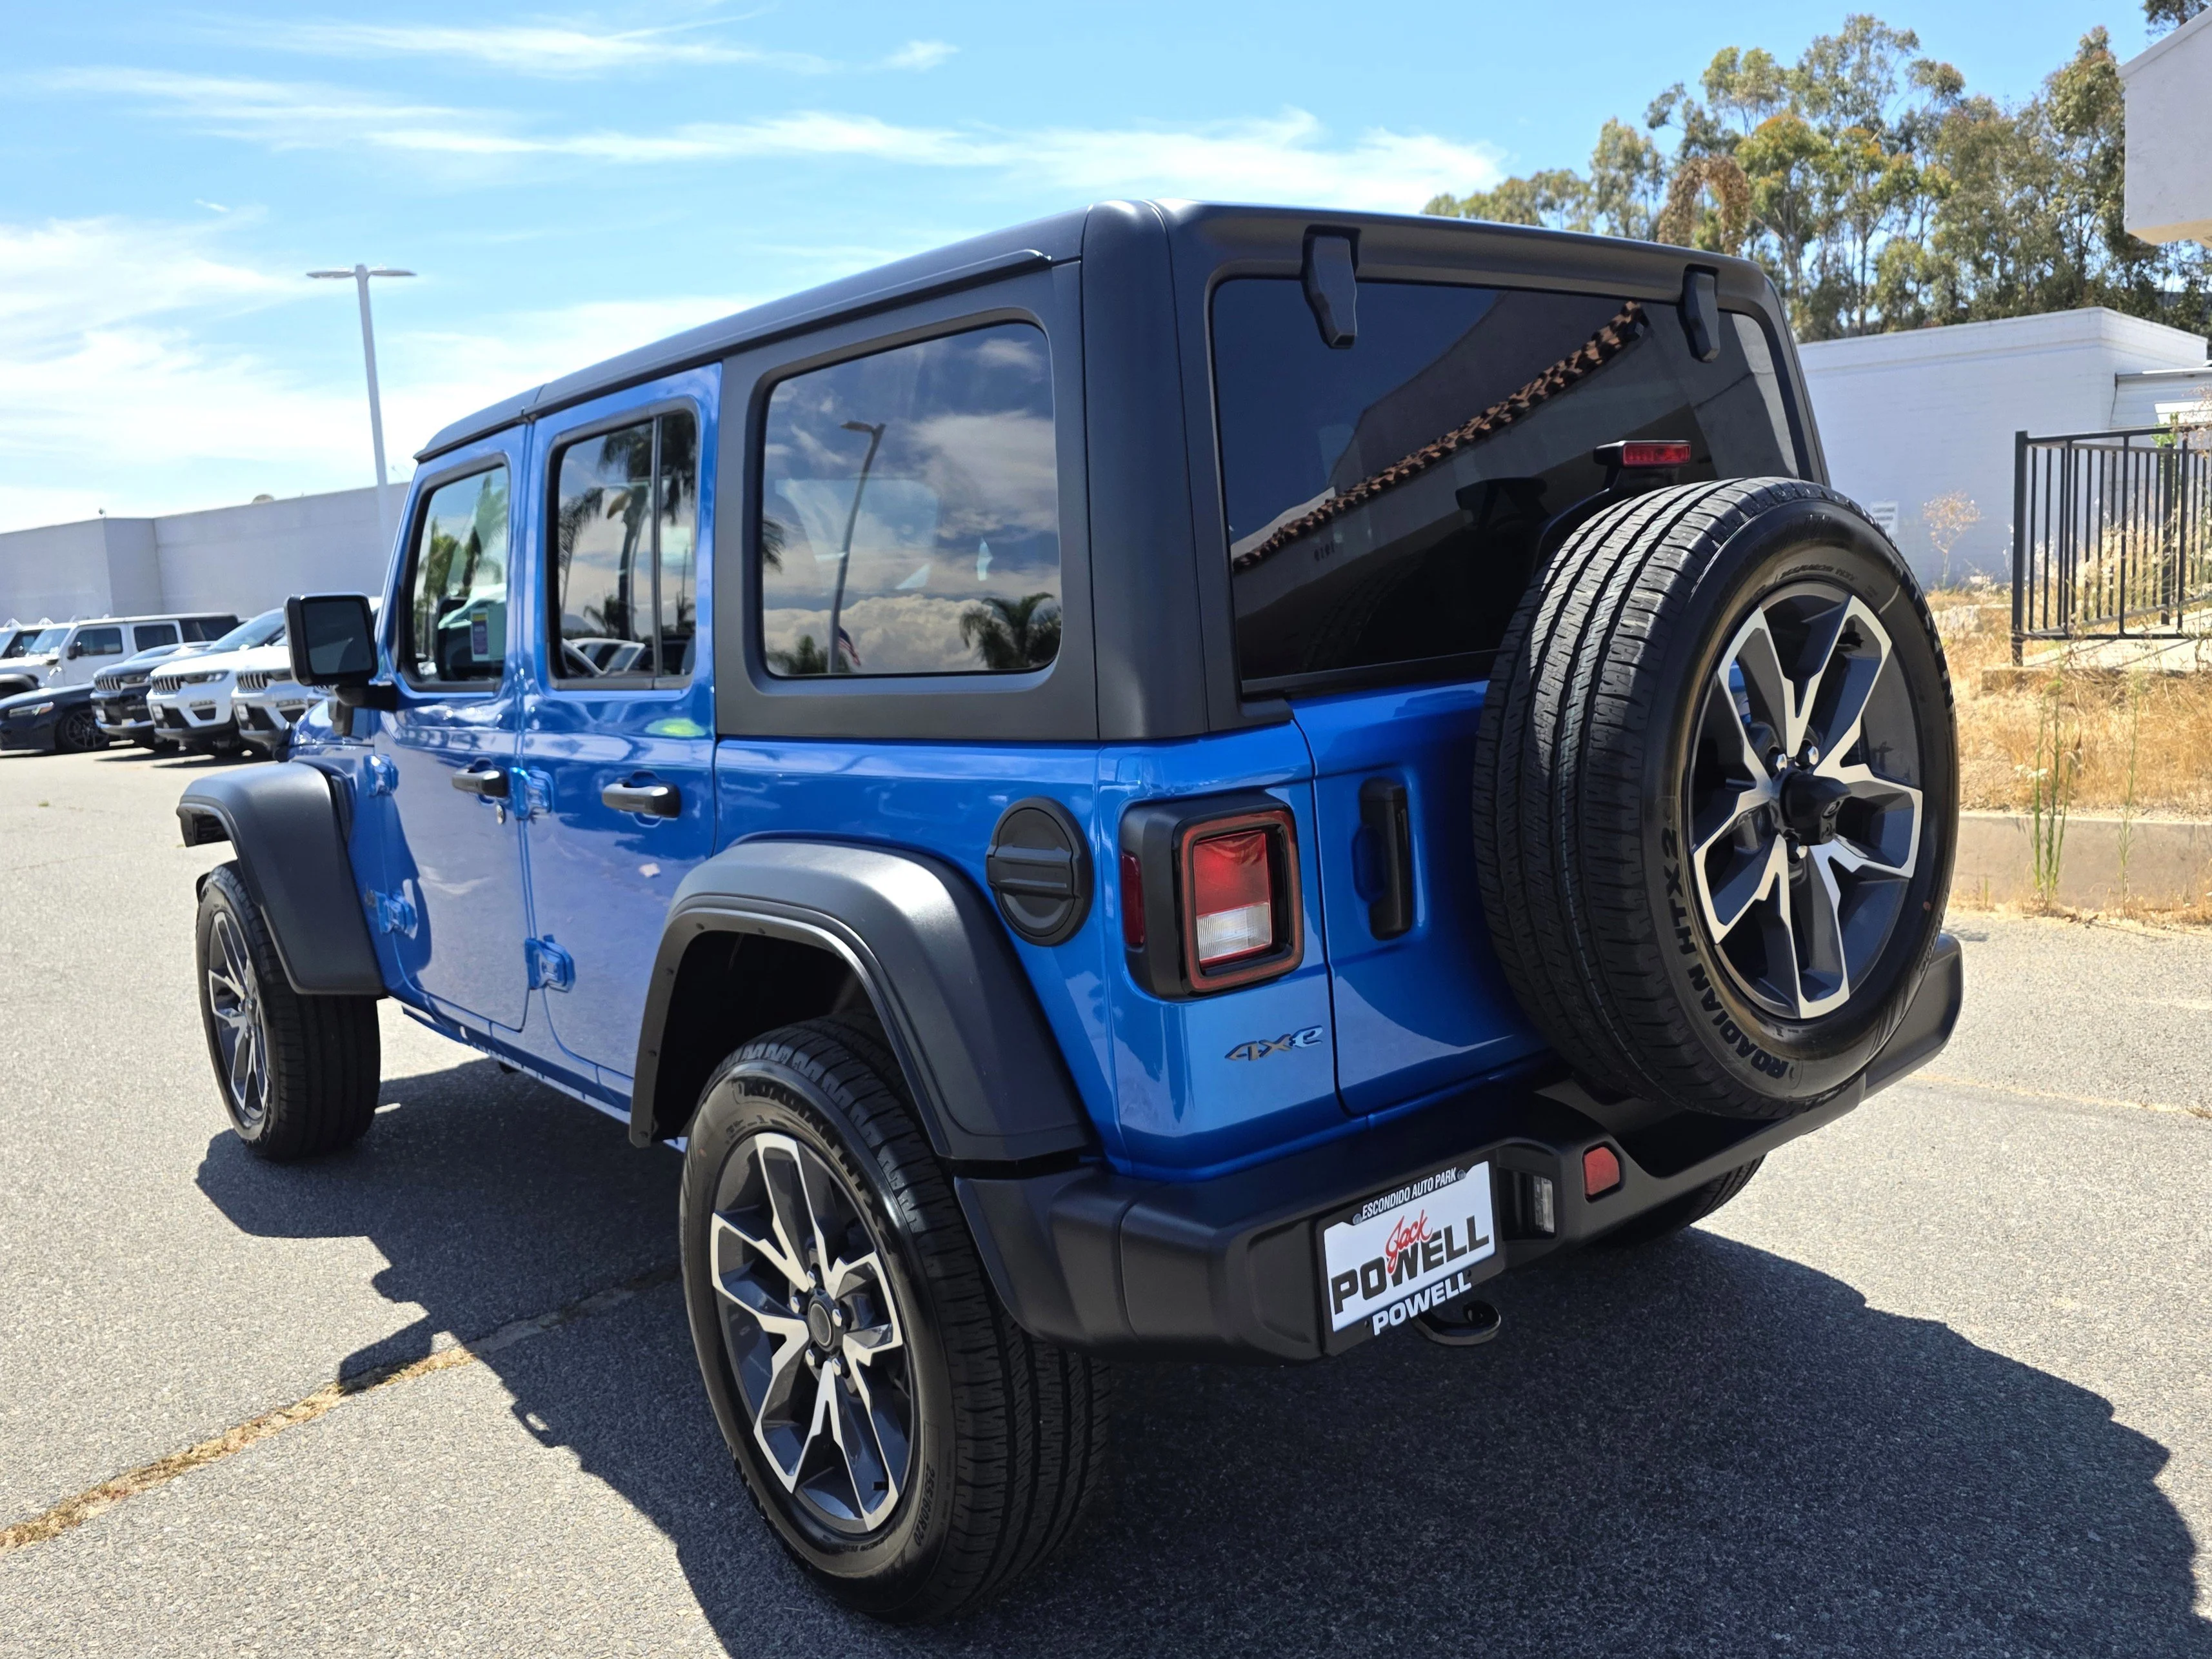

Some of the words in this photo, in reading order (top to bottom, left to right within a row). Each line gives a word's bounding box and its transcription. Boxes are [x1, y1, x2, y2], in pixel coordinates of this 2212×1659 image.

[1687, 963, 1789, 1079] ROADIAN
[1362, 1187, 1410, 1220] ESCONDIDO
[1411, 1176, 1433, 1198] AUTO
[1435, 1167, 1457, 1189] PARK
[1331, 1217, 1490, 1315] POWELL
[1385, 1209, 1432, 1273] Jack
[1372, 1272, 1472, 1336] POWELL
